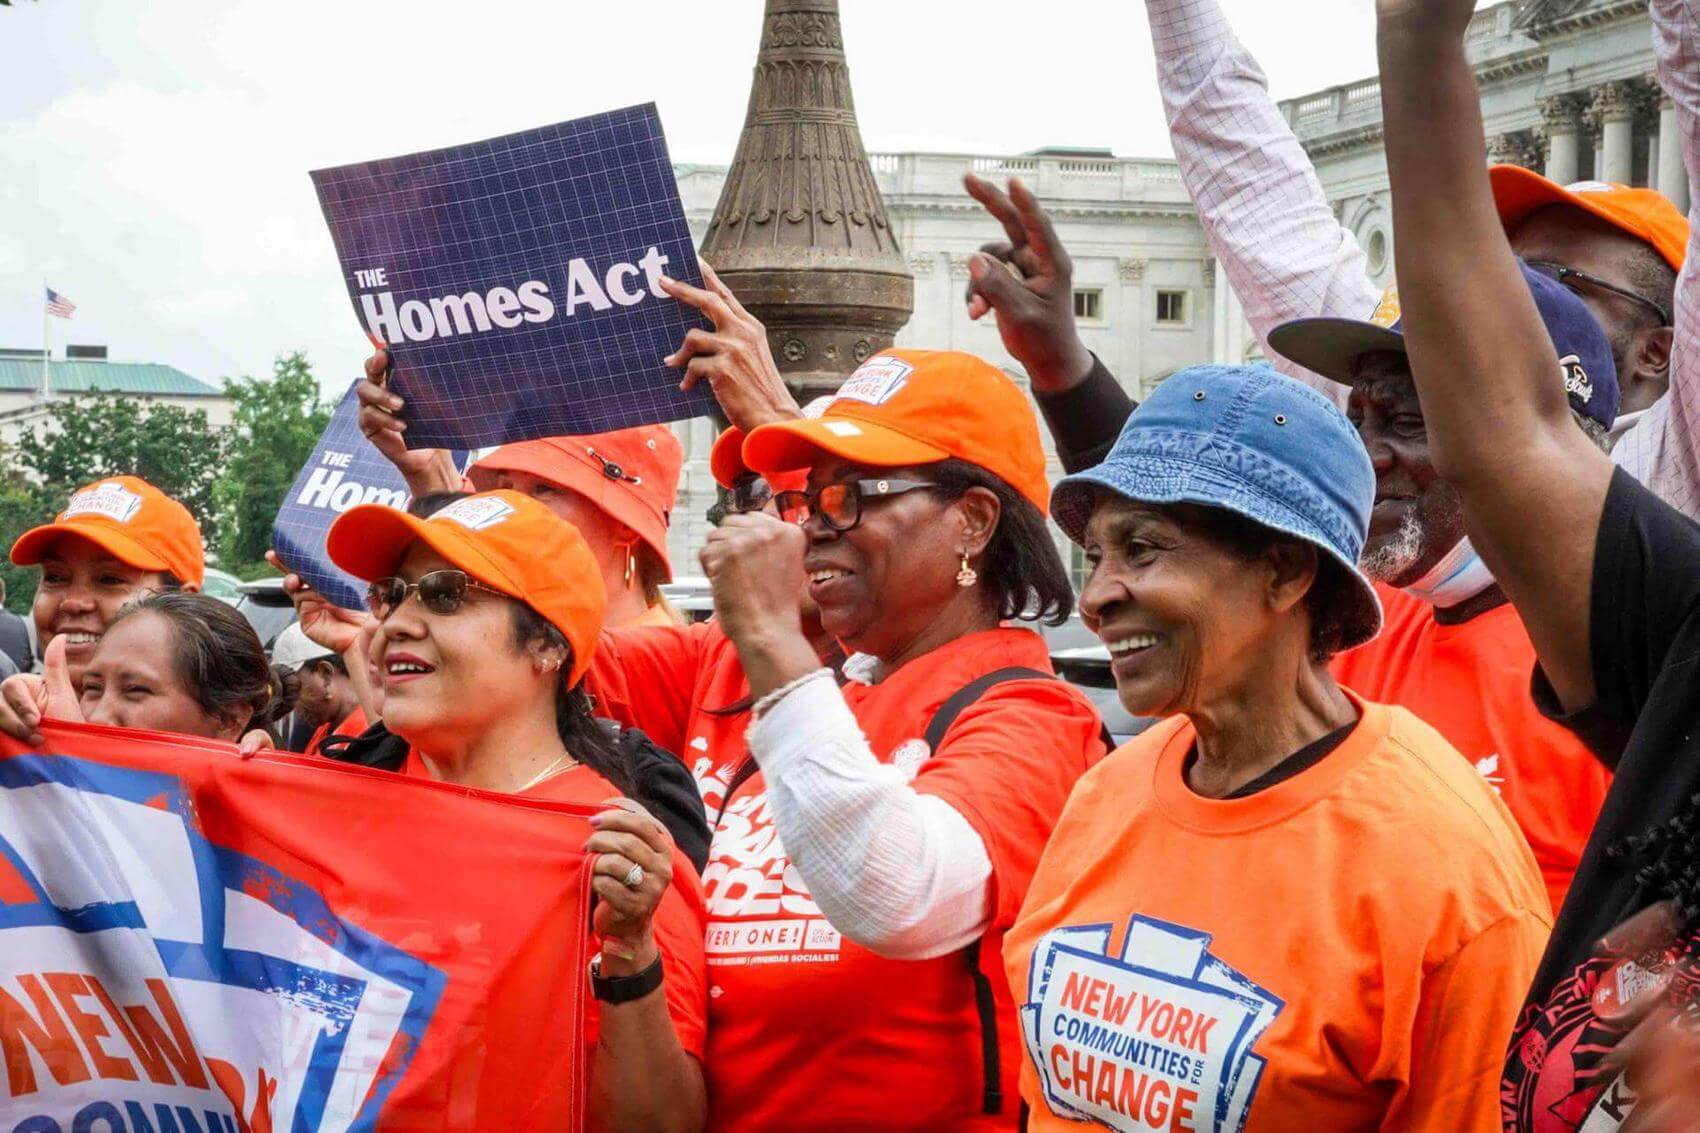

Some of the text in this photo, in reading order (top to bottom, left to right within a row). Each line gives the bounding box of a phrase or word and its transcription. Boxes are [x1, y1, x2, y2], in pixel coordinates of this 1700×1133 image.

[354, 267, 388, 288] THE
[361, 246, 671, 343] Homes Act
[321, 450, 354, 468] THE
[296, 467, 412, 513] Hom
[747, 927, 800, 945] ONE!
[0, 972, 210, 1098] NEW
[1060, 971, 1218, 1055] NEW YORK
[1053, 1013, 1191, 1080] COMMUNITIES
[1190, 1059, 1206, 1085] FOR
[1051, 1043, 1199, 1133] CHANGE
